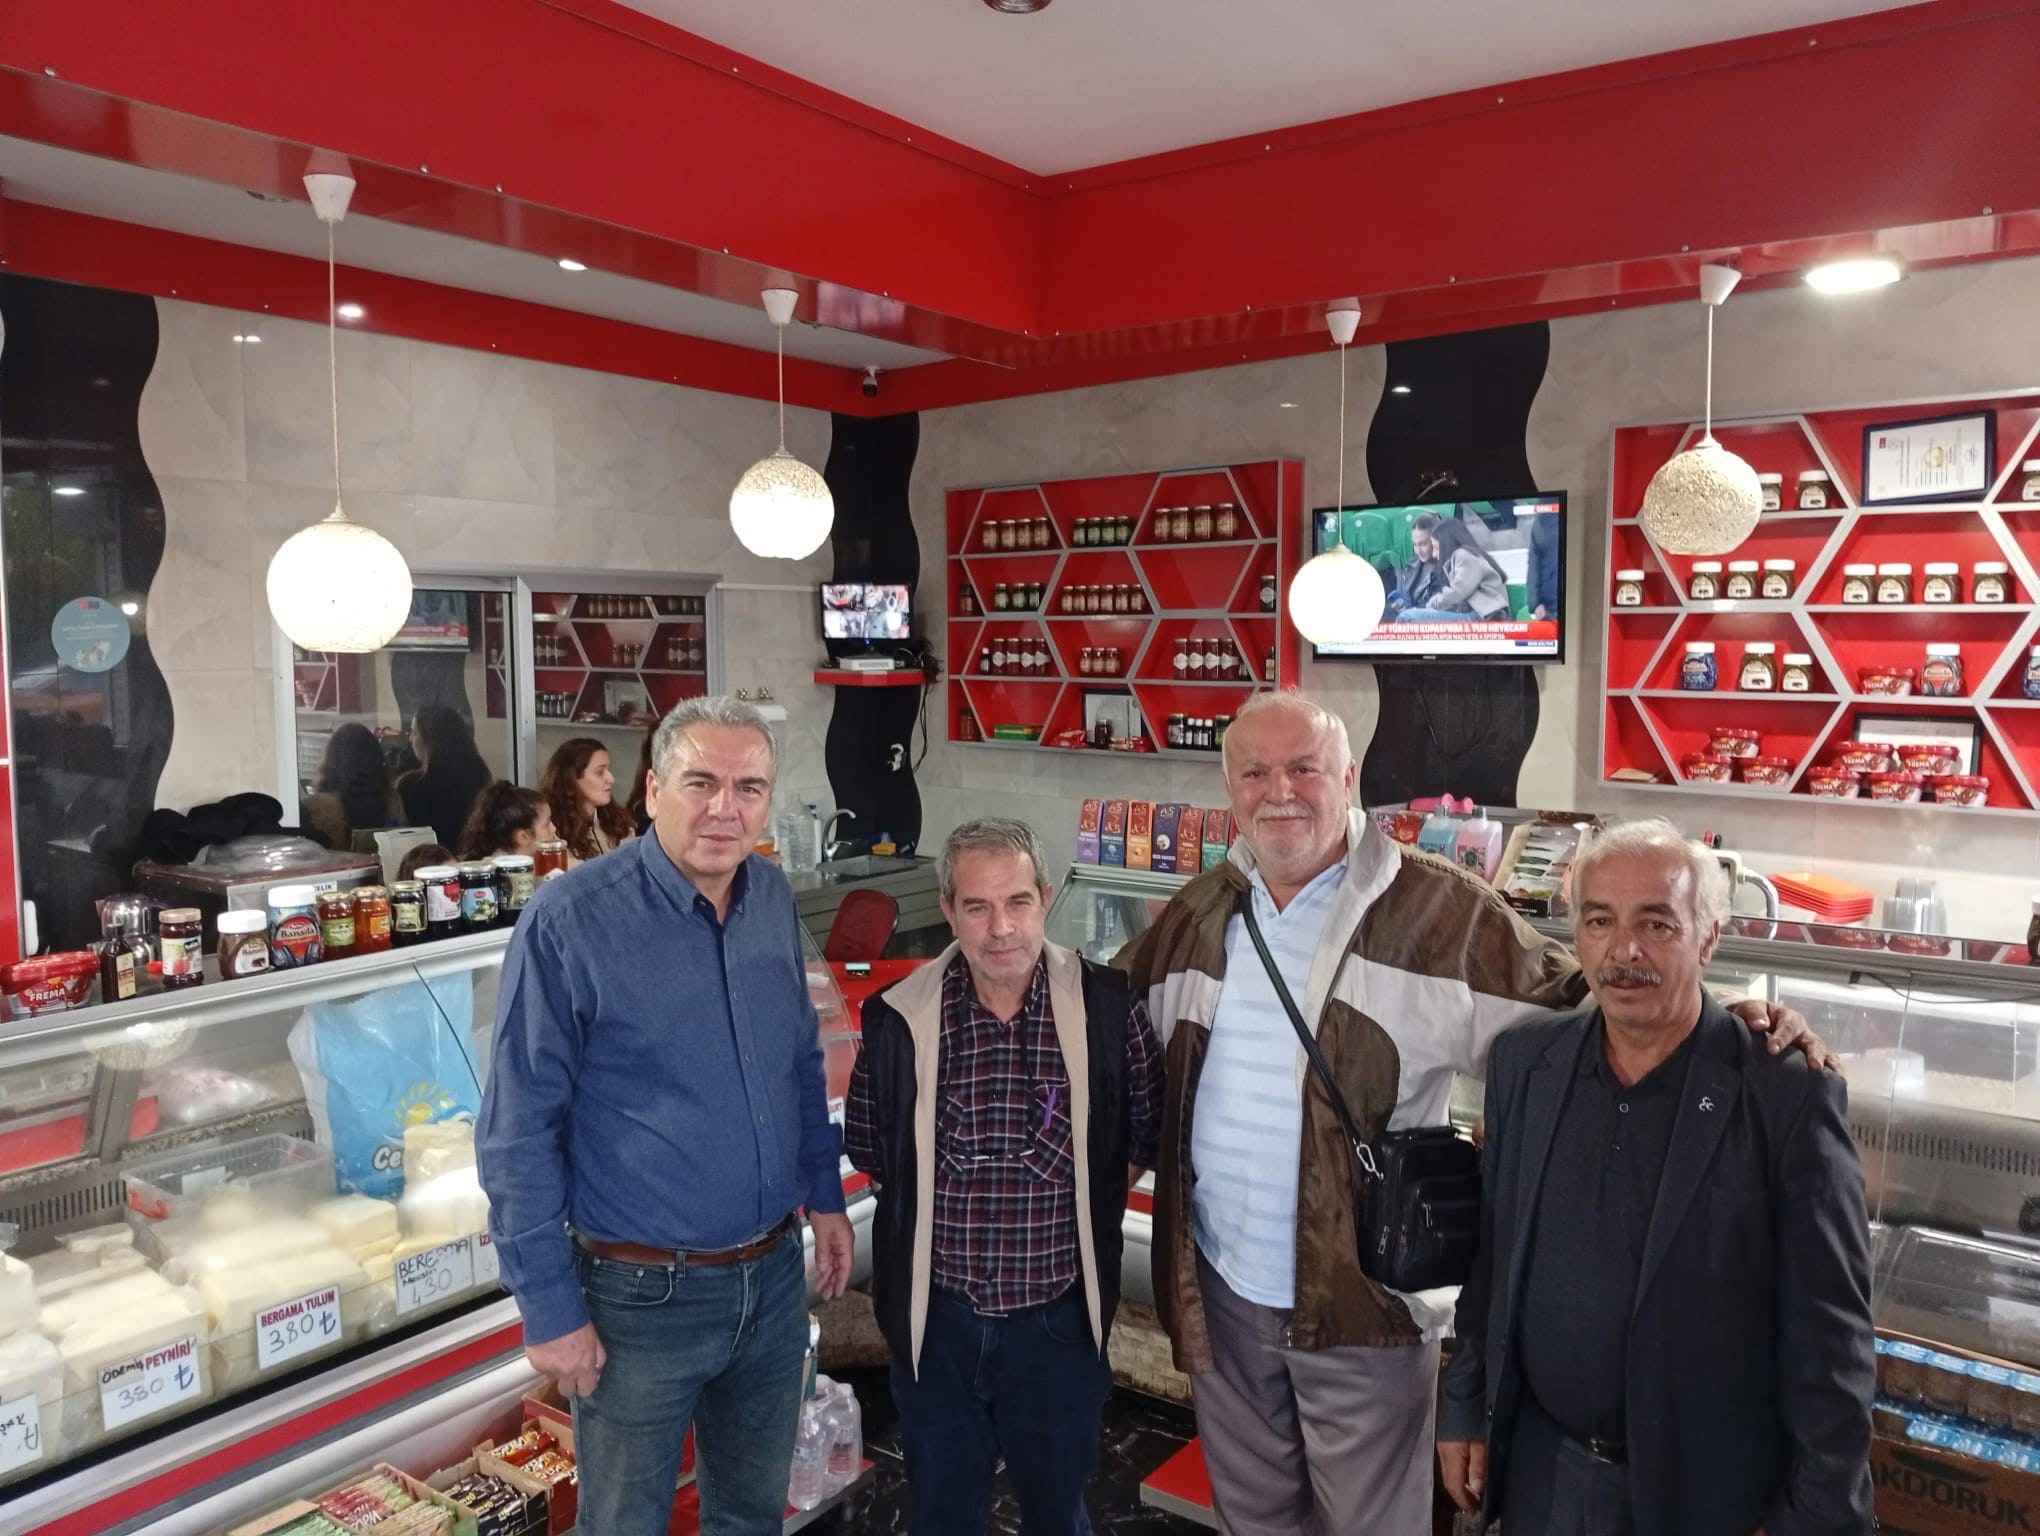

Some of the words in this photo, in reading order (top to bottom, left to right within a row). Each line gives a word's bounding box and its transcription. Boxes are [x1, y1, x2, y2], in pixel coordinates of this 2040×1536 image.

[30, 988, 66, 1002] FREMA
[261, 1302, 304, 1328] BERGAMA
[305, 1290, 335, 1311] TULUM
